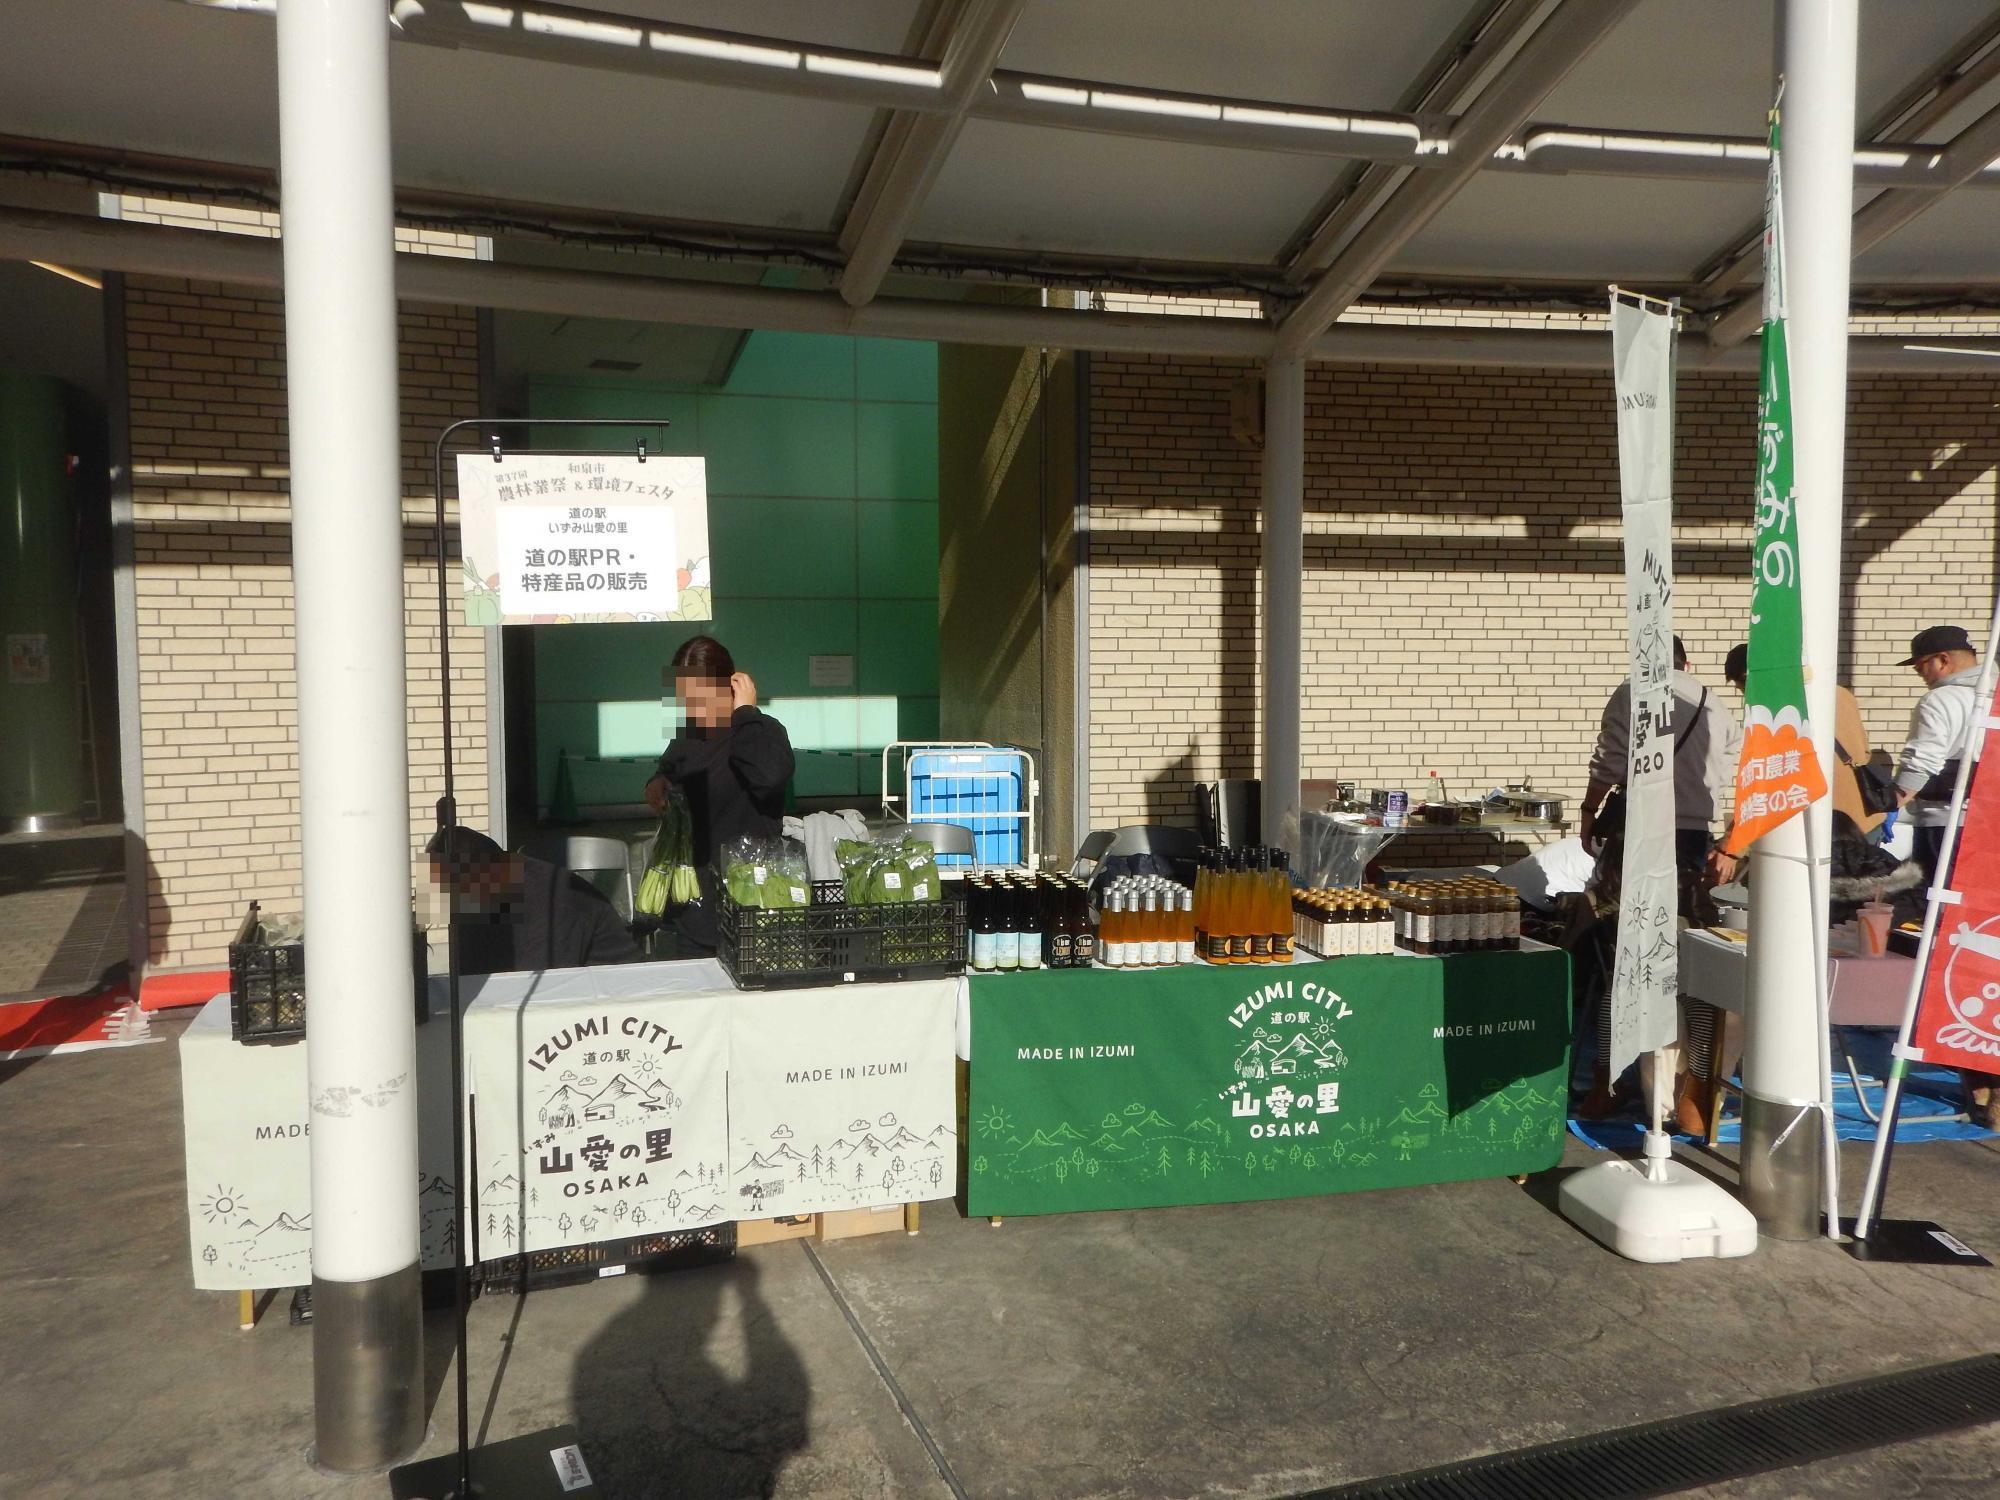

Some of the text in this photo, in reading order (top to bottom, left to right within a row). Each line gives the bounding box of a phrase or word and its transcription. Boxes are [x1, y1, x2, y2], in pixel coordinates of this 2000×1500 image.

[568, 462, 606, 474] 和泉市
[498, 476, 567, 502] 農林業祭
[587, 476, 675, 500] 環境フェスタ
[568, 507, 607, 519] 道の駅
[548, 522, 629, 534] いずみ山愛の里
[525, 548, 637, 568] 道の駅PR・
[521, 571, 648, 592] 特産品の販売
[1228, 981, 1353, 1029] IZUMI CITY
[1270, 1011, 1311, 1025] 道の駅
[1433, 1019, 1536, 1039] MADE IN IZUMI
[528, 1016, 683, 1072] IZUMI CITY
[1017, 1045, 1135, 1060] MADE IN IZUMI
[583, 1049, 631, 1066] 道の駅
[786, 1062, 908, 1083] MADE IN IZUMI
[1218, 1080, 1248, 1100] いずみ
[1232, 1082, 1340, 1119] 山愛の里
[1249, 1120, 1320, 1139] OSAKA
[521, 1132, 556, 1155] いずみ
[540, 1127, 673, 1174] 山愛の里
[563, 1172, 649, 1198] OSAKA
